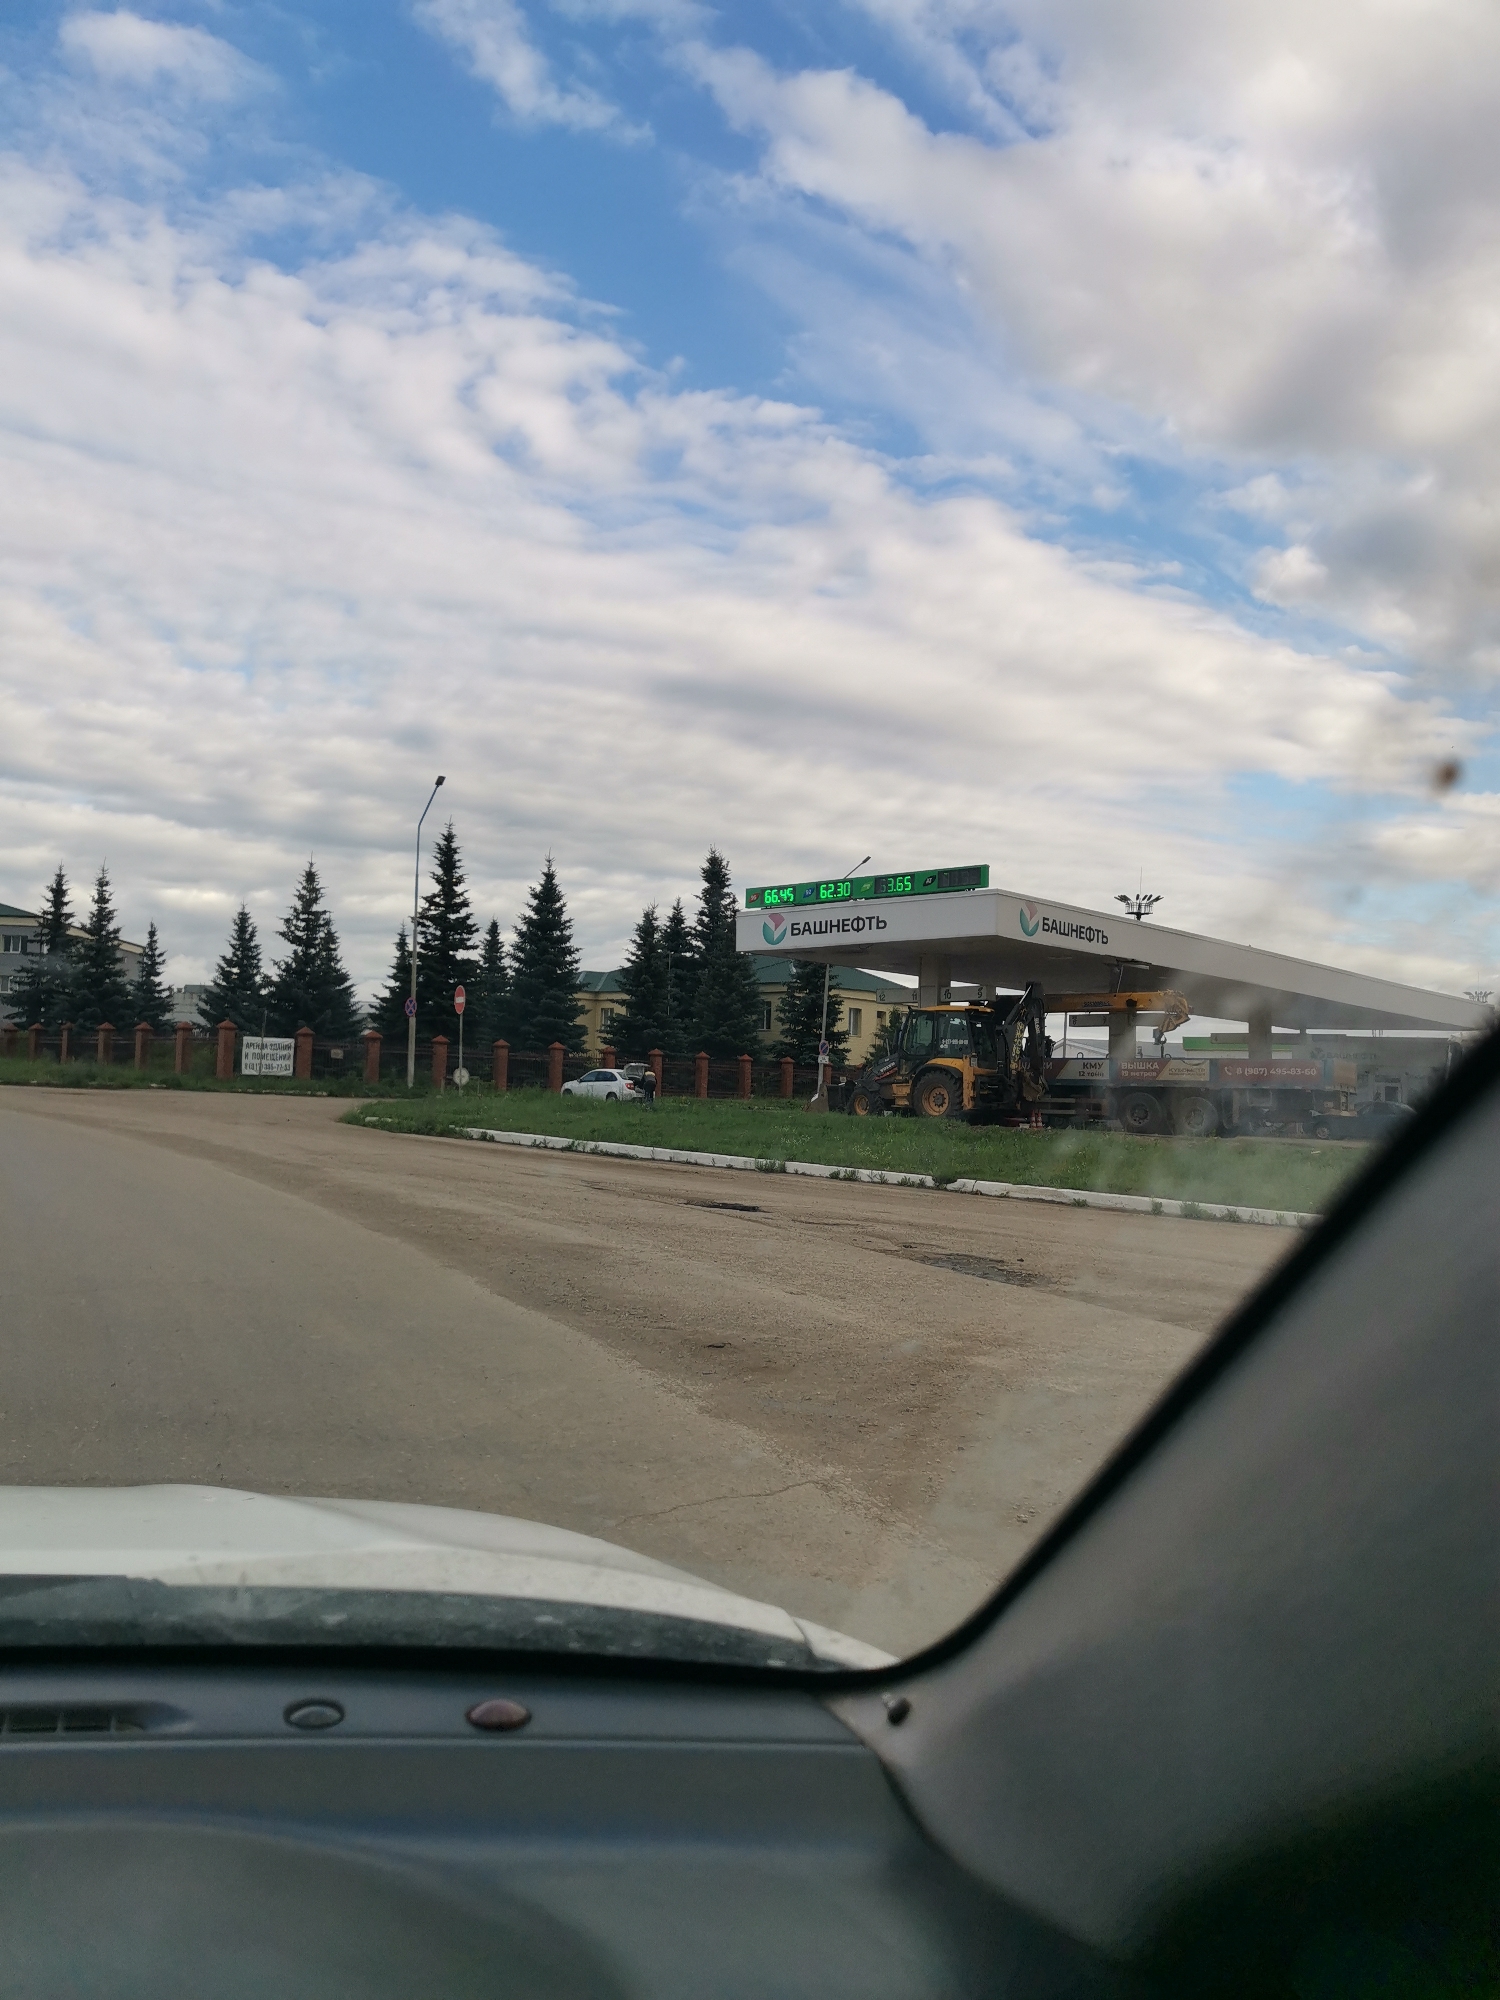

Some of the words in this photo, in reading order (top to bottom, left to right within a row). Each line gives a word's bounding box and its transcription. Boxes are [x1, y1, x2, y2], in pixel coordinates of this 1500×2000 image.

[819, 881, 851, 898] 62.30
[764, 887, 794, 904] 66.45
[790, 915, 888, 937] БАШНЕФТЬ
[1042, 916, 1109, 945] БАШНЕФТЬ
[878, 993, 886, 1002] 12
[911, 992, 918, 1000] 11
[943, 992, 952, 1000] 10
[977, 991, 983, 999] 9
[1082, 1062, 1104, 1070] КМУ
[1121, 1061, 1160, 1070] ВЫШКА
[1244, 1066, 1268, 1076] (987)
